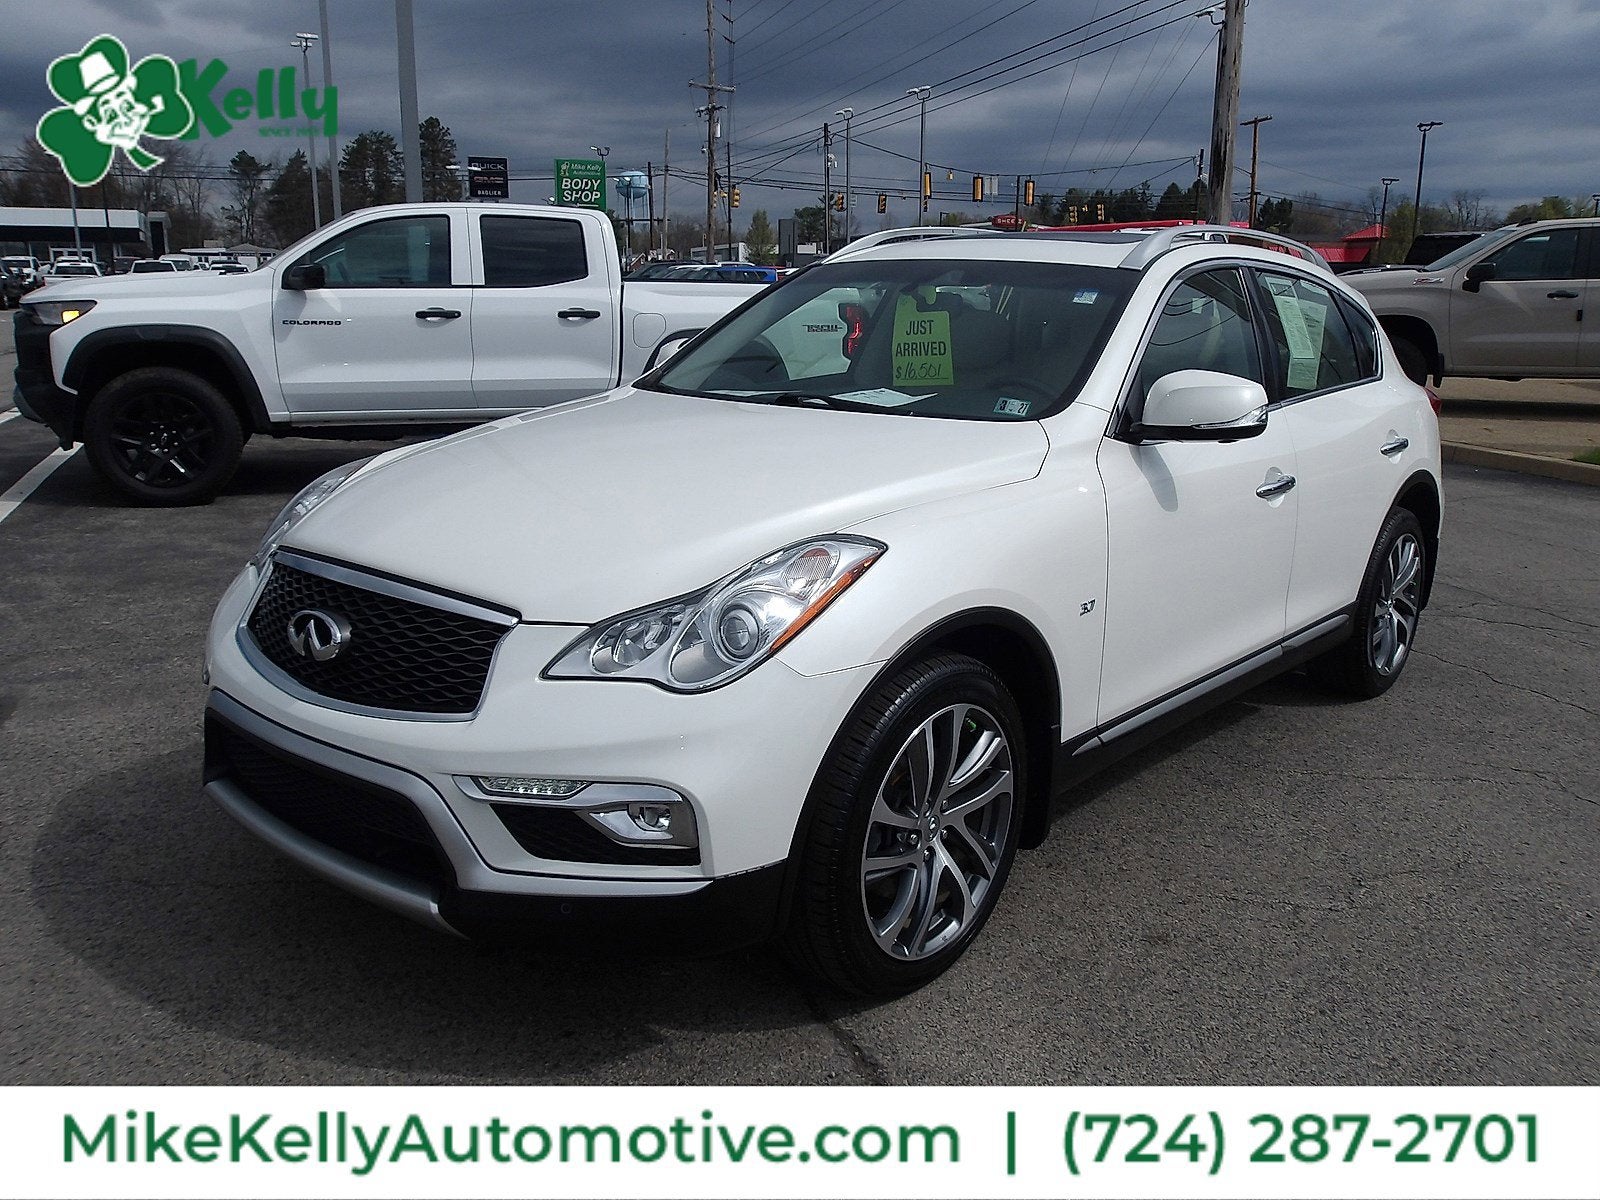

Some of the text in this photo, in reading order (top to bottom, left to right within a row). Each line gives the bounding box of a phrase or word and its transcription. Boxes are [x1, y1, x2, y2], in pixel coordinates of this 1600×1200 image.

[561, 178, 601, 190] BODY
[562, 190, 601, 202] SHOP
[905, 319, 935, 336] JUST
[895, 341, 947, 357] ARRIVED
